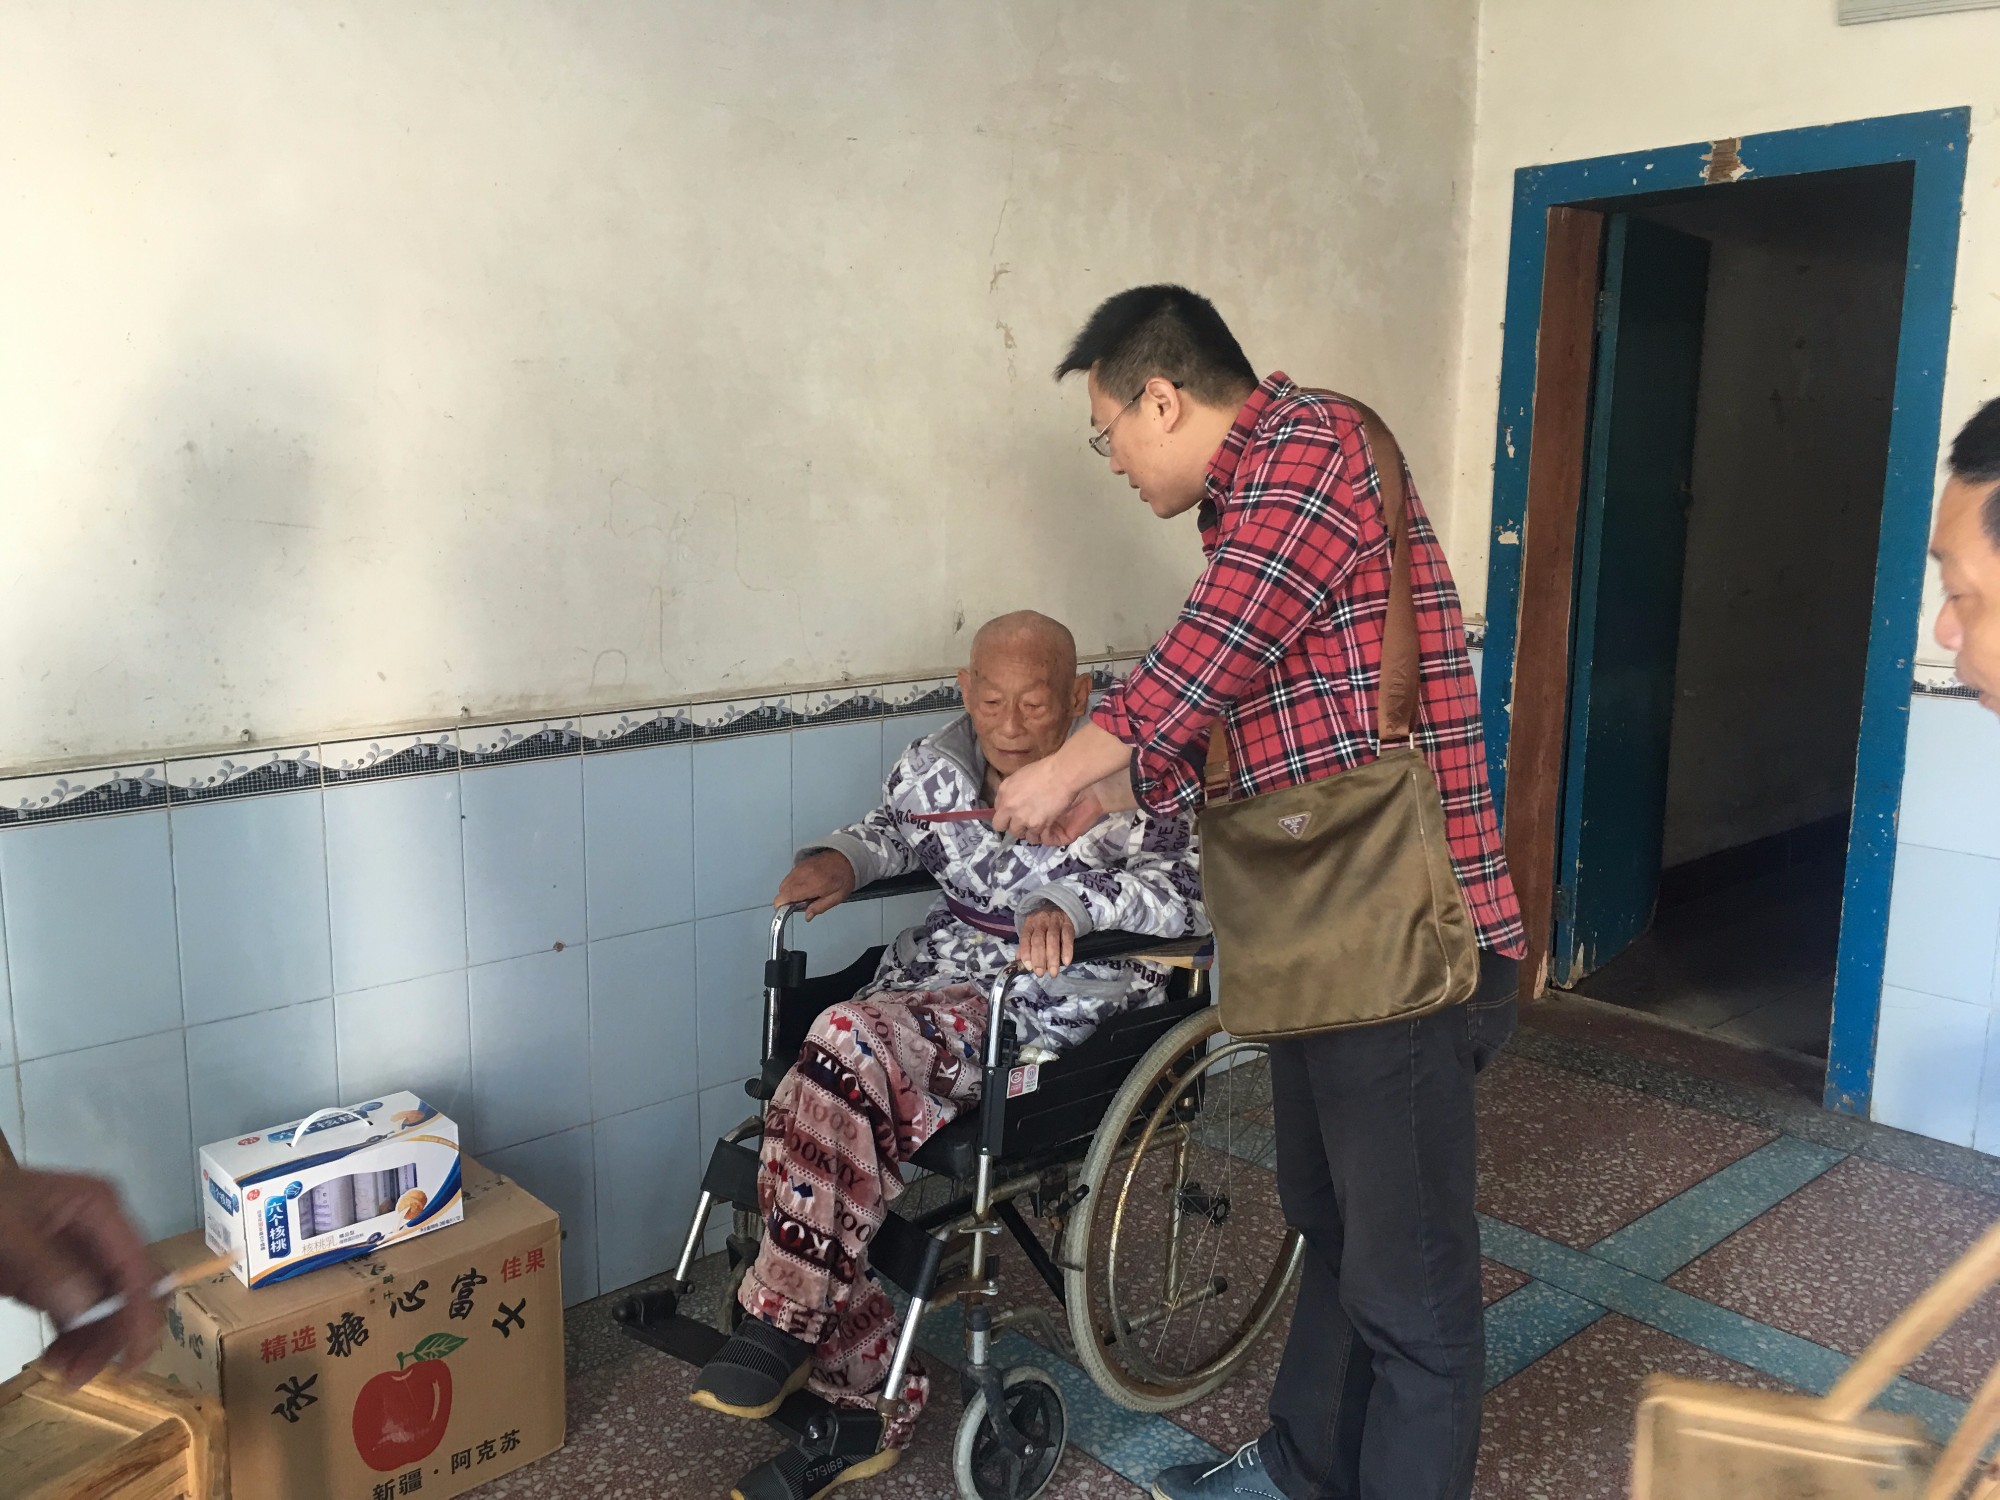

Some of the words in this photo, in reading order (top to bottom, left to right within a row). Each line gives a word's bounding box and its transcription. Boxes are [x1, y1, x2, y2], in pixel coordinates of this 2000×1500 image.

[267, 1201, 288, 1253] 六个核桃
[302, 1235, 338, 1256] 核桃乳
[500, 1247, 546, 1284] 佳果
[260, 1325, 317, 1364] 精选
